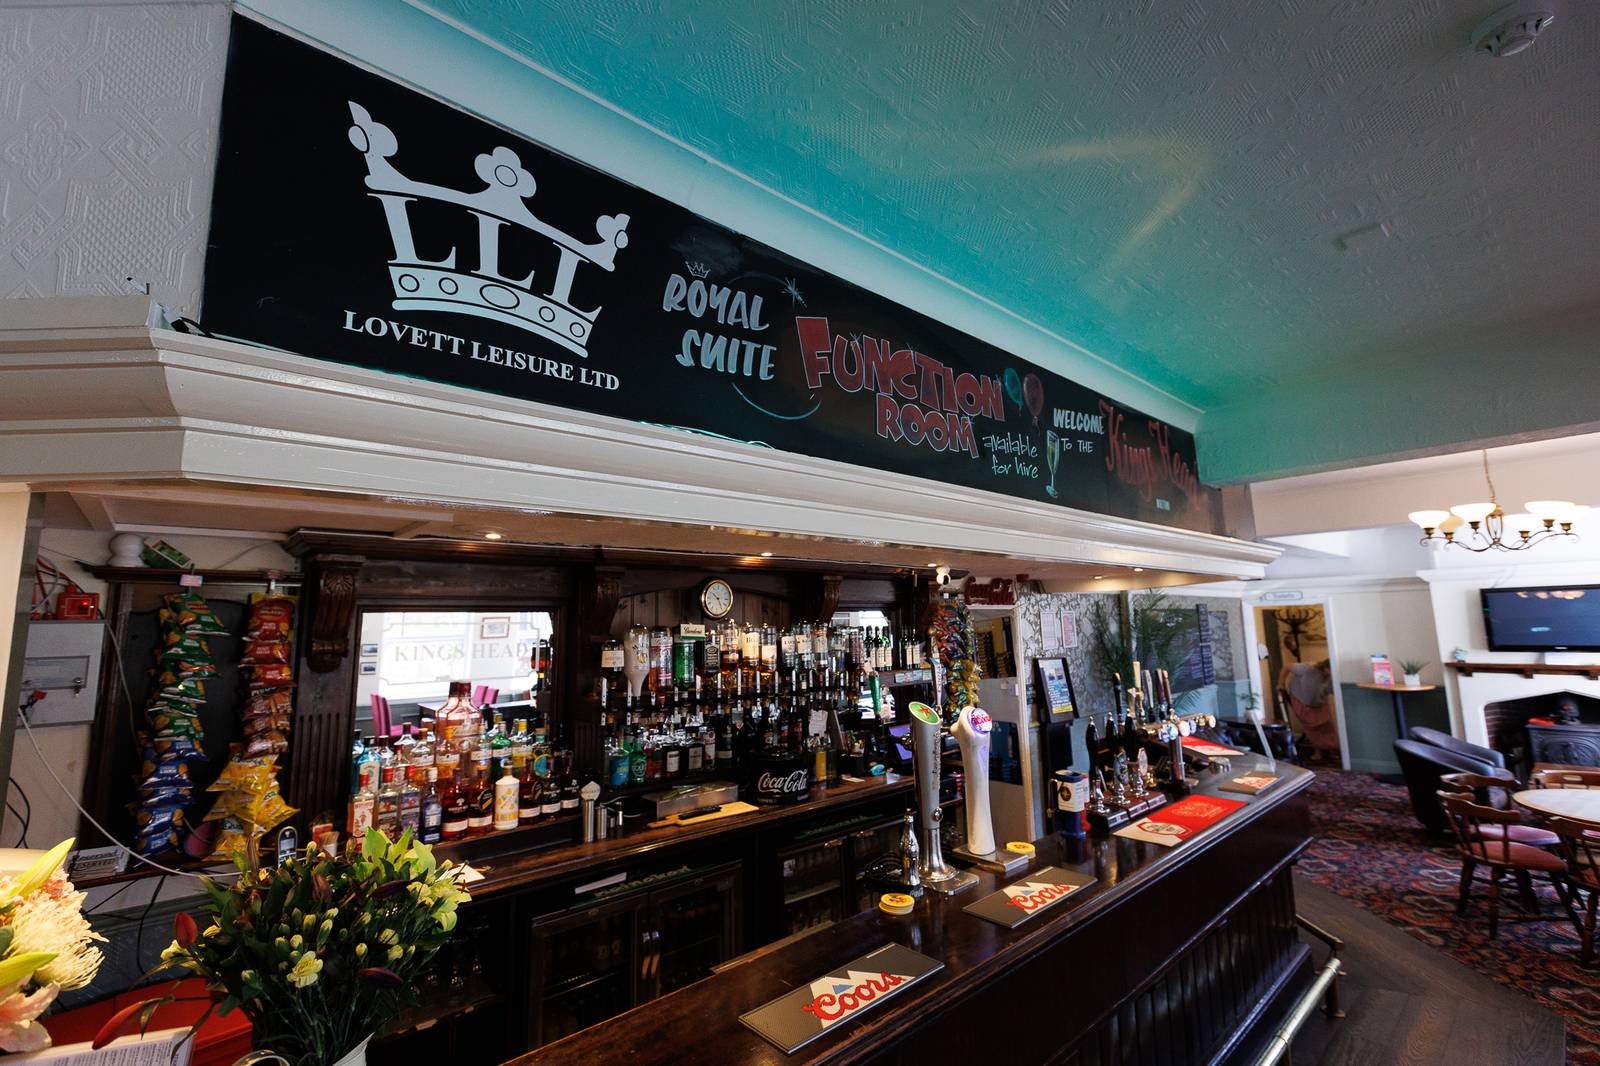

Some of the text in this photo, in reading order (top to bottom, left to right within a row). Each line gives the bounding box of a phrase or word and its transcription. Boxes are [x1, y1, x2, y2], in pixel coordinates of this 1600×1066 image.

[662, 273, 769, 331] ROYAL
[343, 309, 620, 391] LOVETT LEISURE LTD
[675, 329, 777, 380] SUITE
[795, 316, 1005, 422] FUNCTION
[876, 393, 979, 458] ROOM
[1053, 407, 1105, 436] WELCOME
[982, 432, 1039, 458] available
[1077, 440, 1093, 453] THE
[991, 454, 1039, 479] for hire
[394, 642, 529, 662] KINGS HEAD
[1007, 882, 1070, 911] Coors
[802, 969, 902, 1022] Coors
